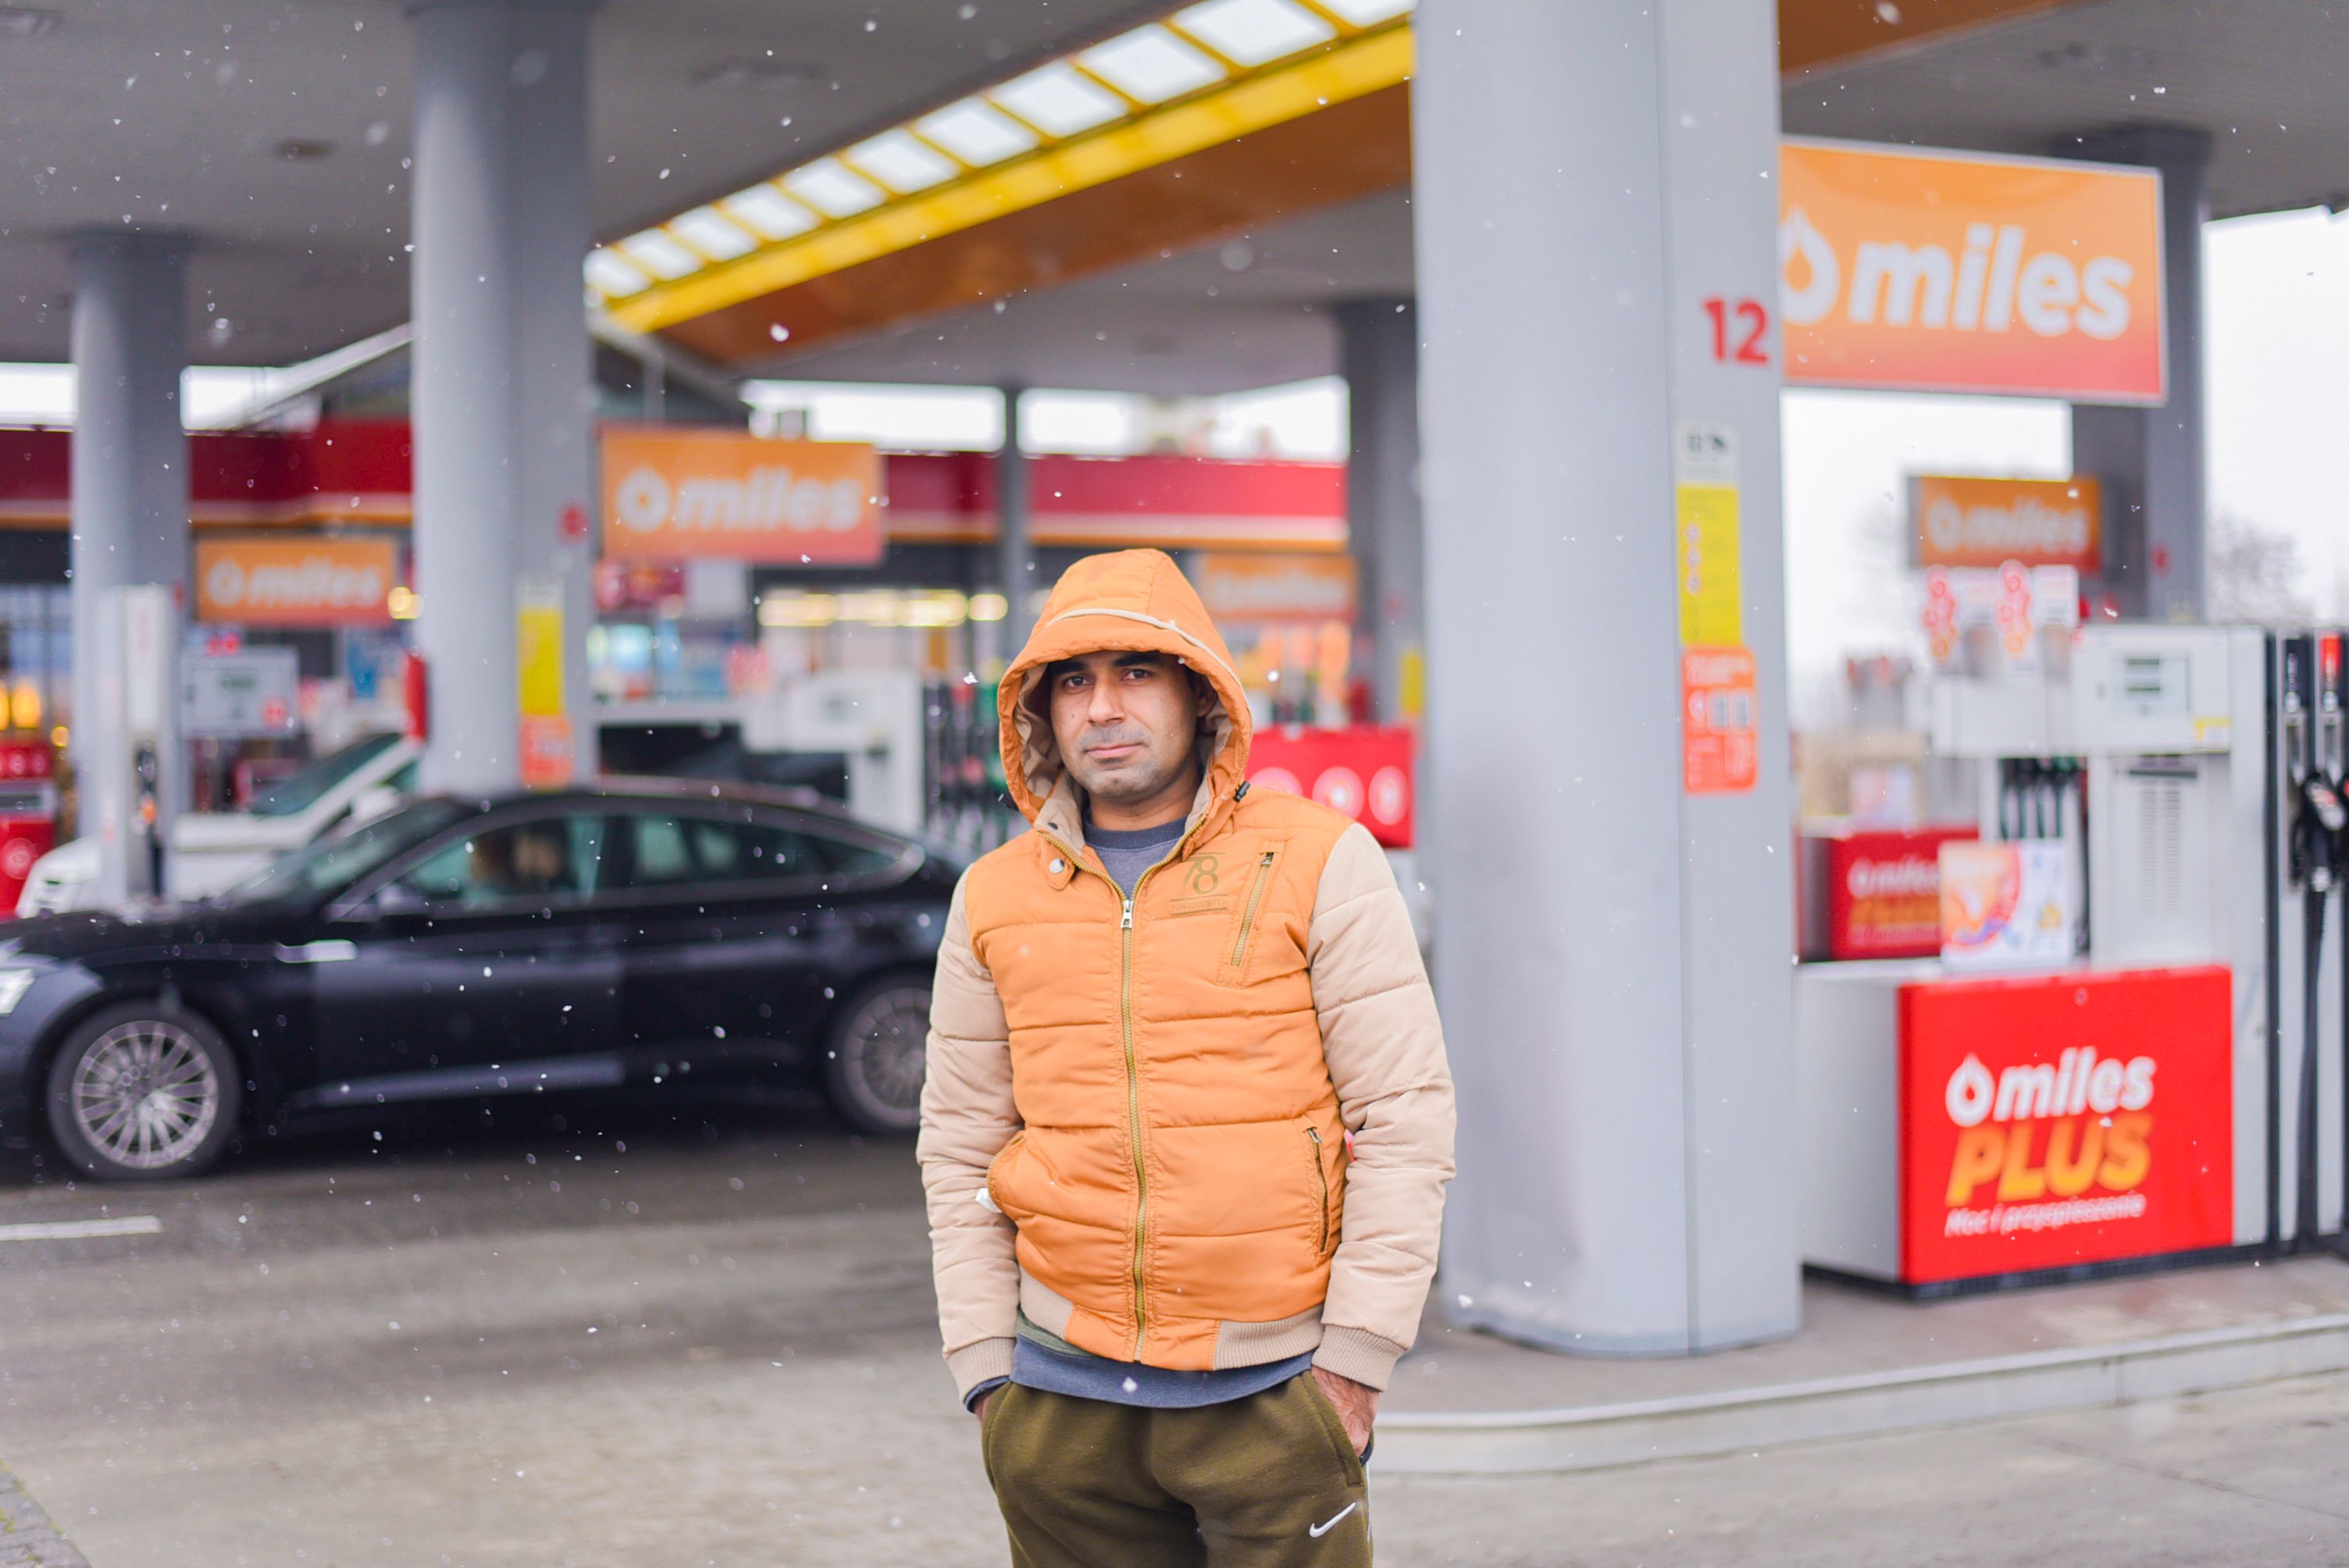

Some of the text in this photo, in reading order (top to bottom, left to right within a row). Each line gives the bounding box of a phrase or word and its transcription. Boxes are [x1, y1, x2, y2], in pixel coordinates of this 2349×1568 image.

[1848, 222, 2134, 340] miles
[1702, 296, 1770, 367] 12
[675, 465, 864, 532] miles
[1992, 1046, 2157, 1122] miles
[1946, 1111, 2154, 1207] PLUS
